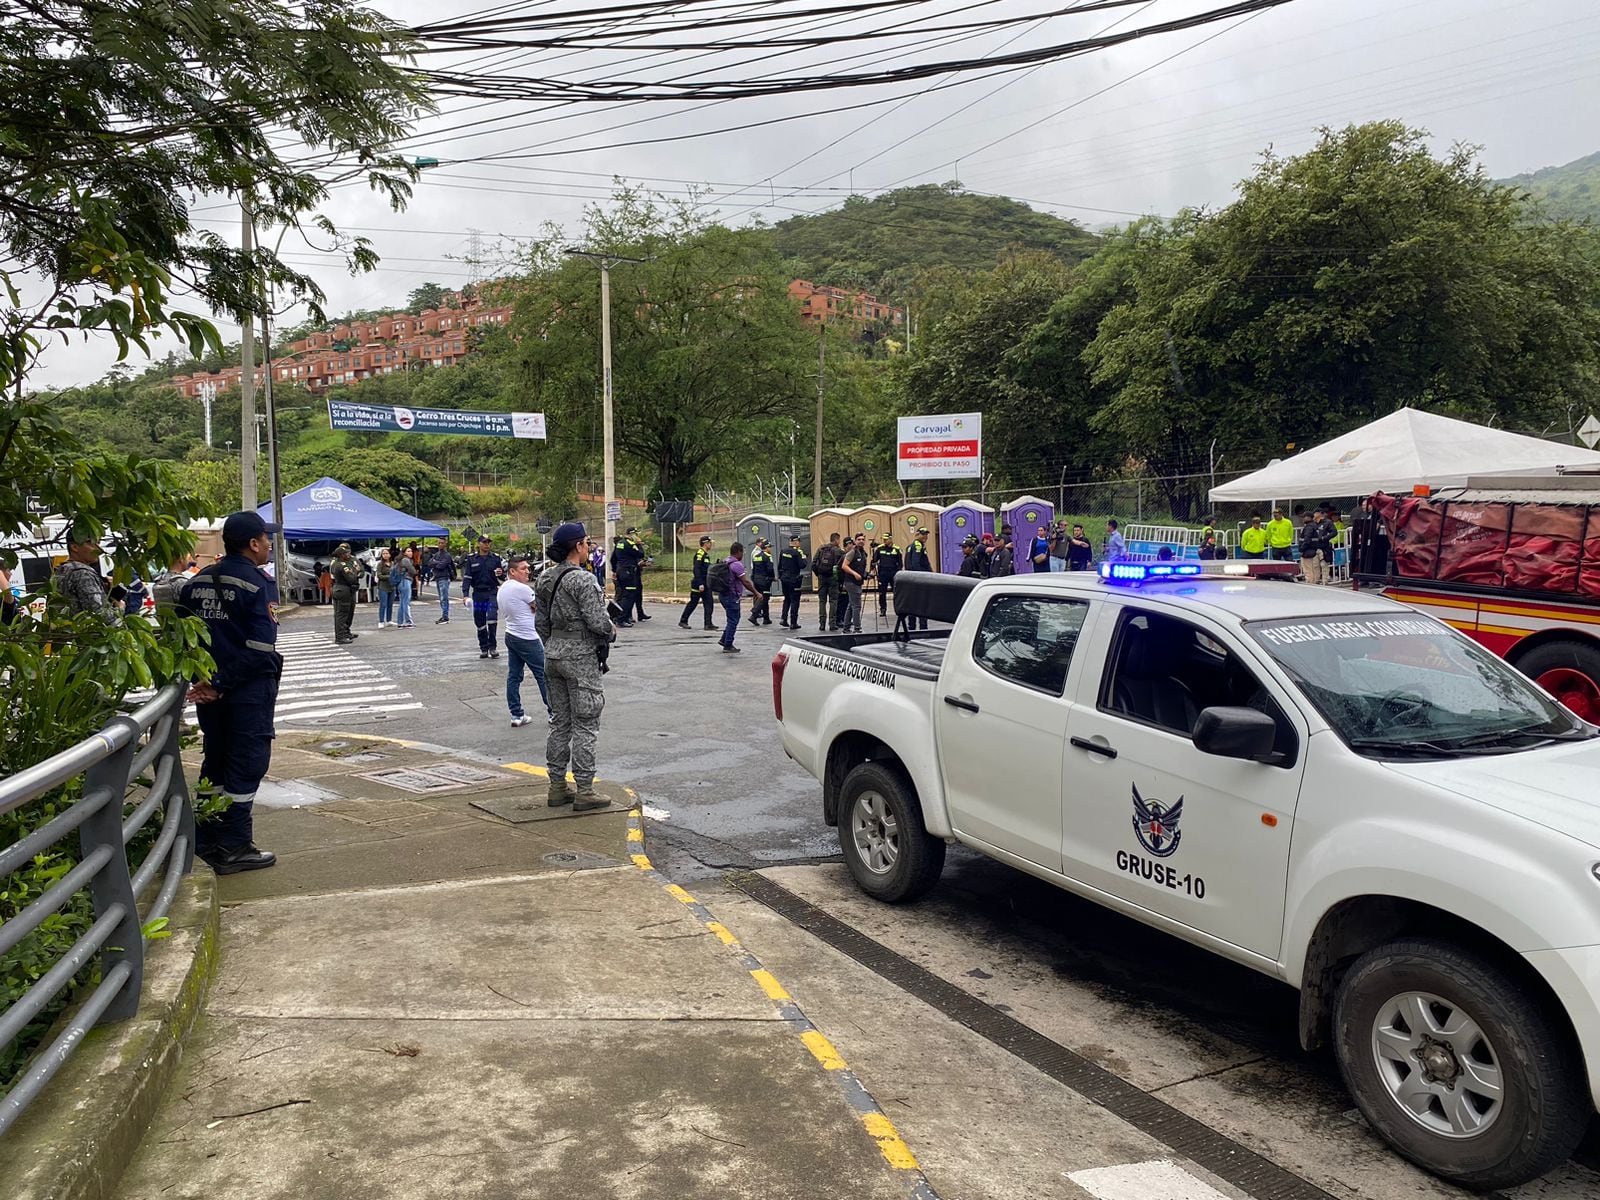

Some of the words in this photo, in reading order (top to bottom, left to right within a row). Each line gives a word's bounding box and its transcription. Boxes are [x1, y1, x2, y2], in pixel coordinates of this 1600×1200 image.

[416, 411, 438, 420] Cerro
[440, 412, 456, 421] Tres
[456, 414, 480, 422] Cruces
[914, 424, 952, 434] Carvajal
[1260, 624, 1326, 646] FUERZA
[1321, 622, 1372, 640] AEREA
[798, 650, 823, 668] FUERZA
[824, 656, 847, 676] AEREA
[846, 662, 896, 690] COLOMBIANA
[1116, 850, 1206, 899] GRUSE-10
